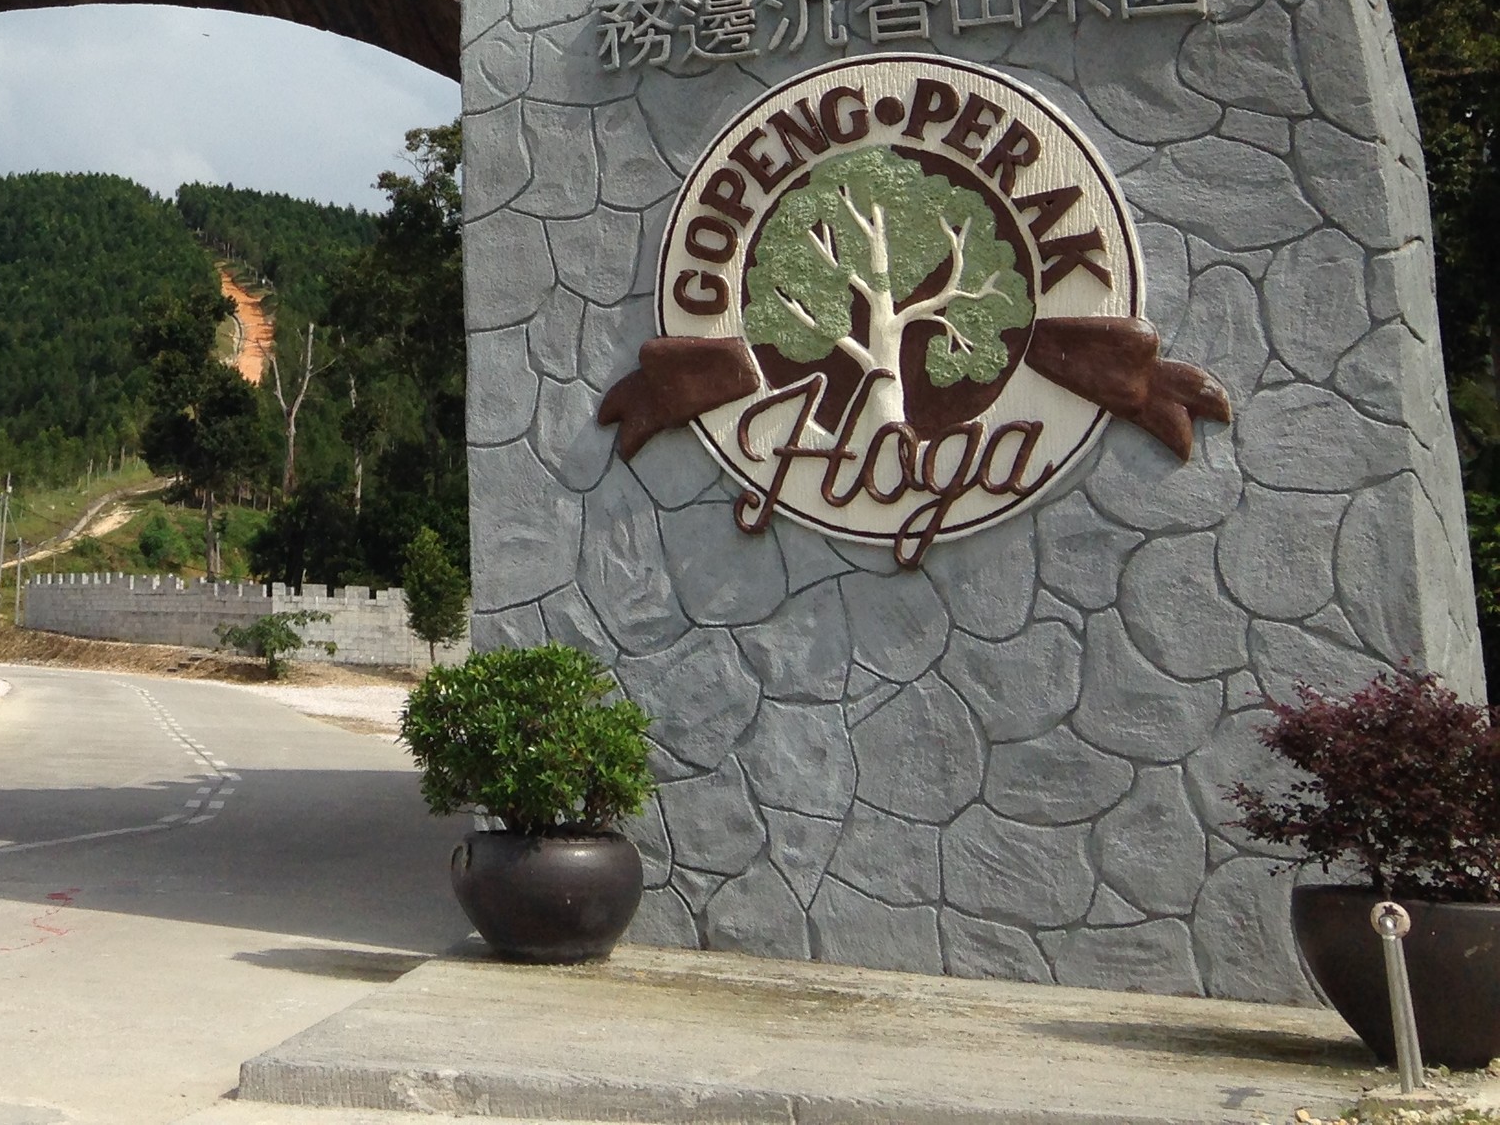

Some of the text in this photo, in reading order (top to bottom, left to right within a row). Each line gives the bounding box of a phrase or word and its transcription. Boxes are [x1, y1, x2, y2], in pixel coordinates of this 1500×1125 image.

[672, 78, 1113, 316] GOPENG PERAK
[733, 368, 1054, 570] Hoga
